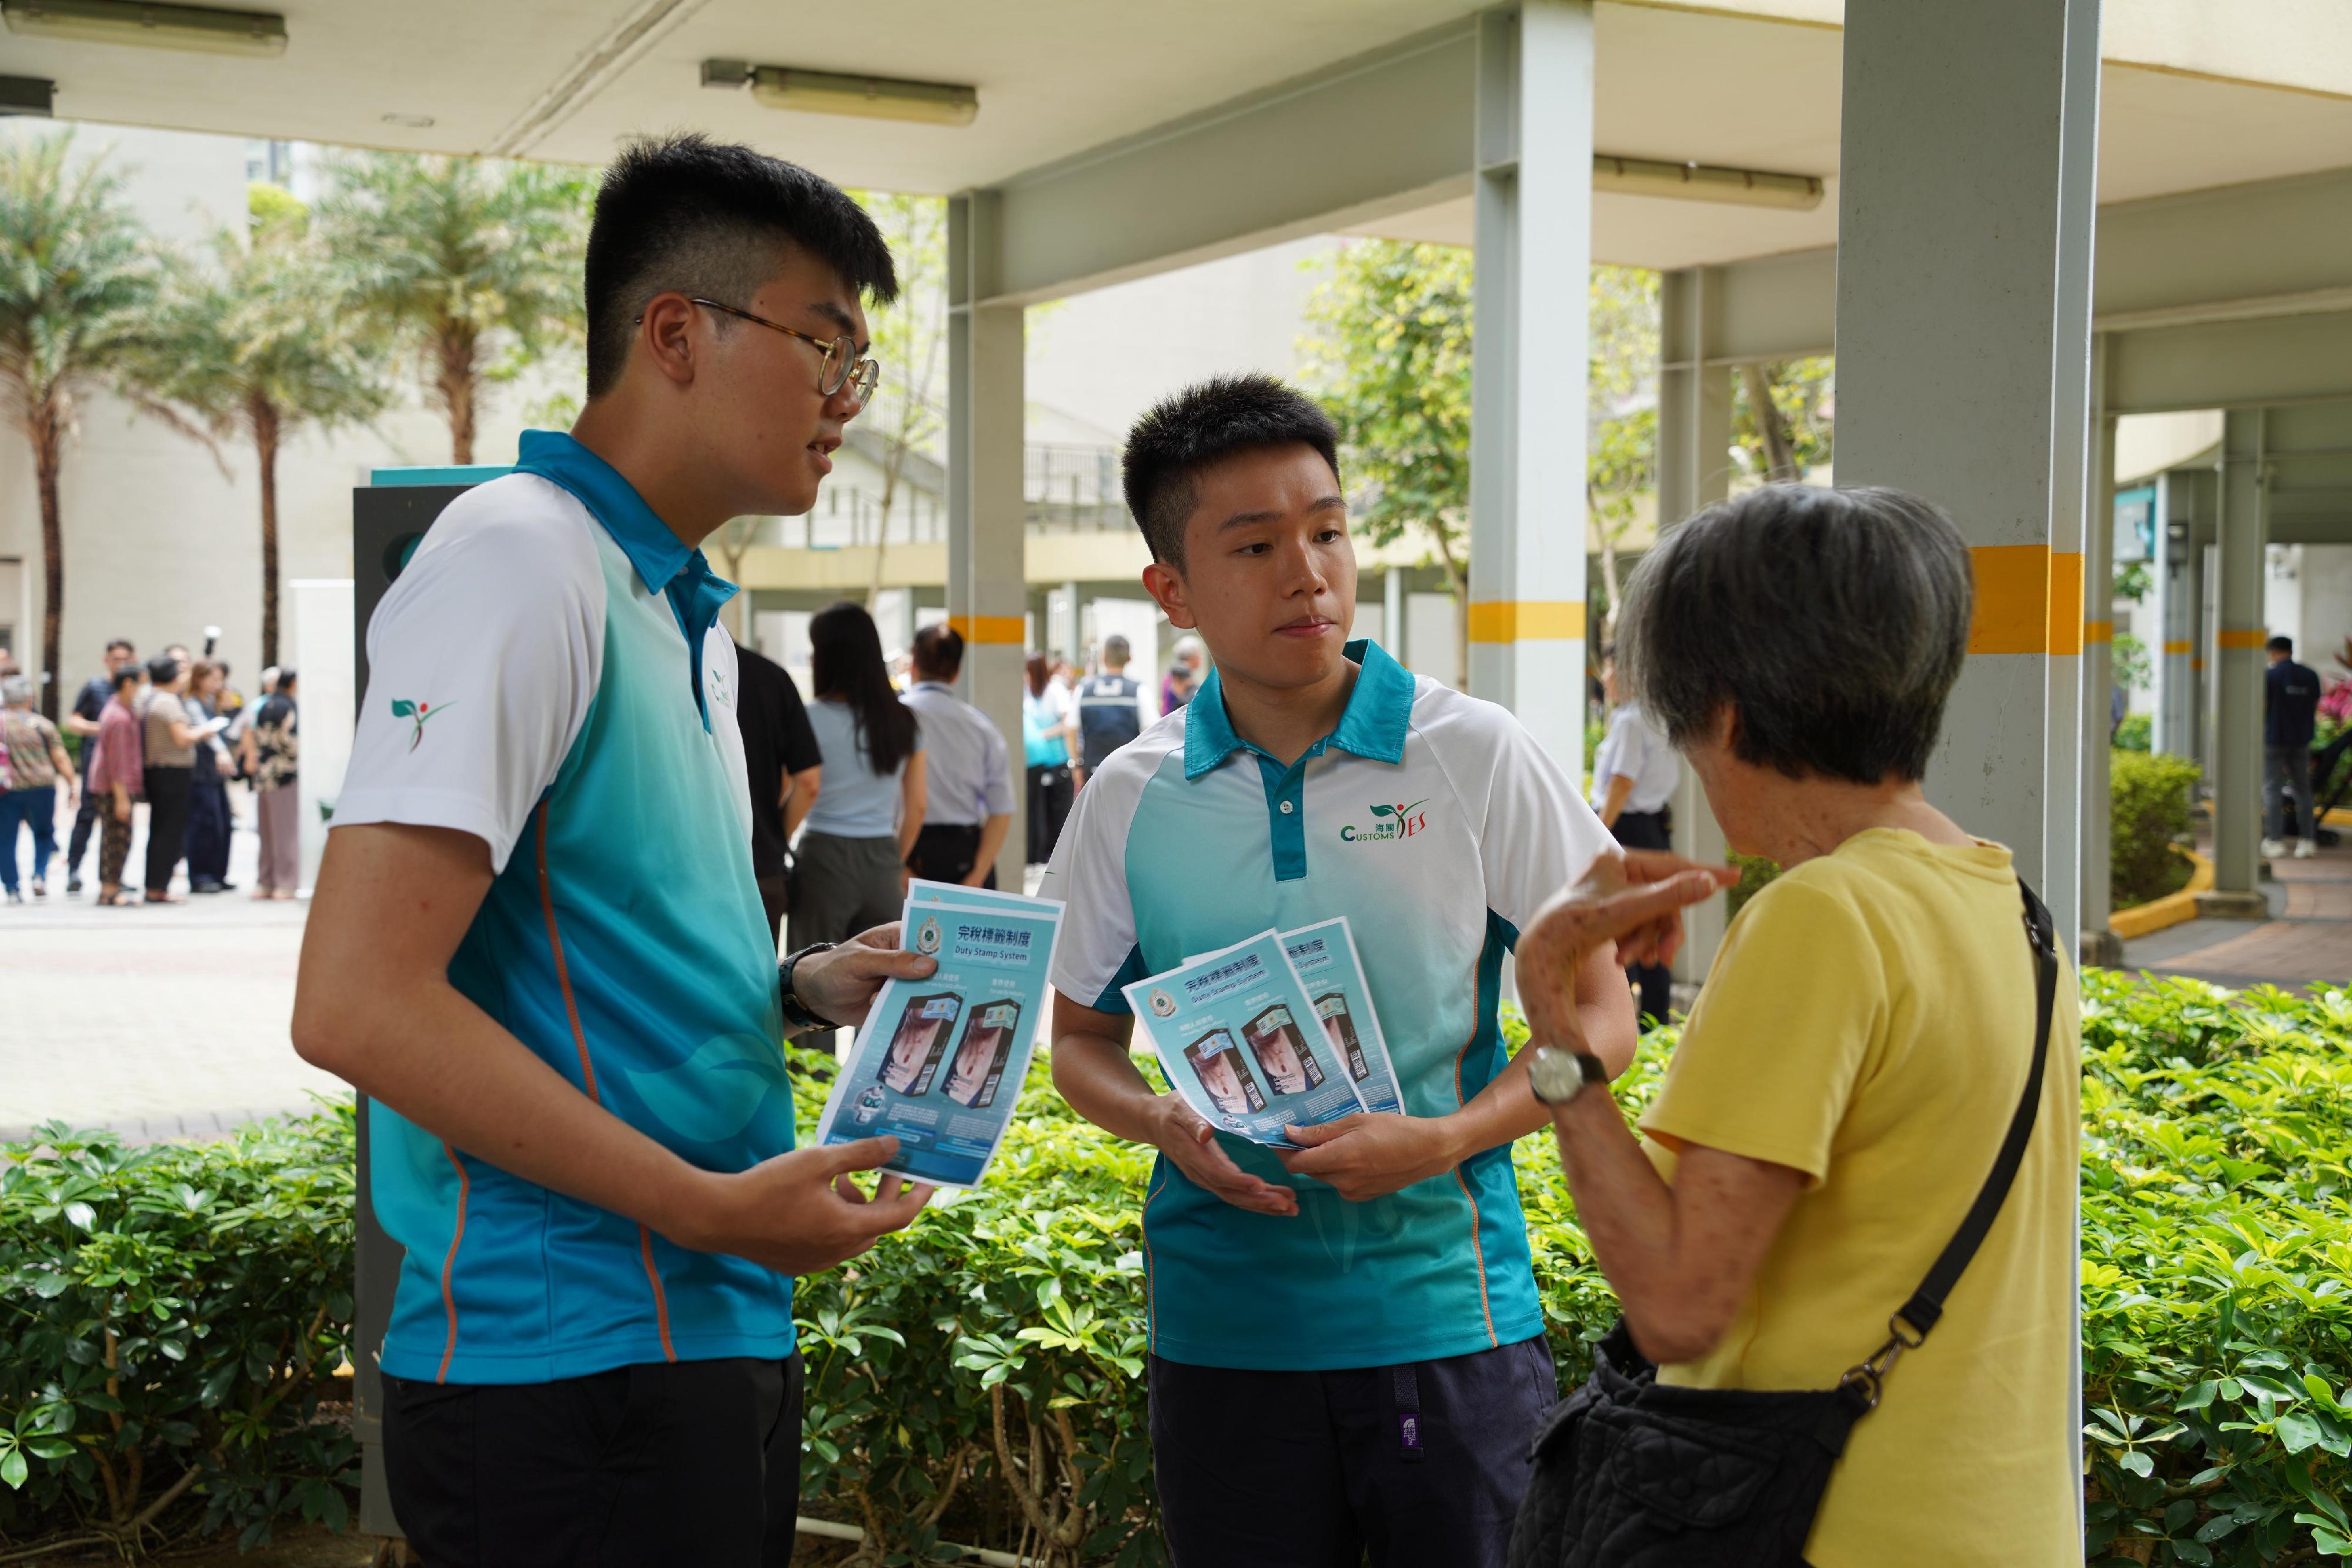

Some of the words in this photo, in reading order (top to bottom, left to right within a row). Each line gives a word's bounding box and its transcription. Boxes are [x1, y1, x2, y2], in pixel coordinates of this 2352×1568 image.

[1375, 823, 1394, 832] 海關
[955, 945, 972, 957] Duty
[974, 948, 998, 959] Stamp
[1000, 950, 1027, 961] System
